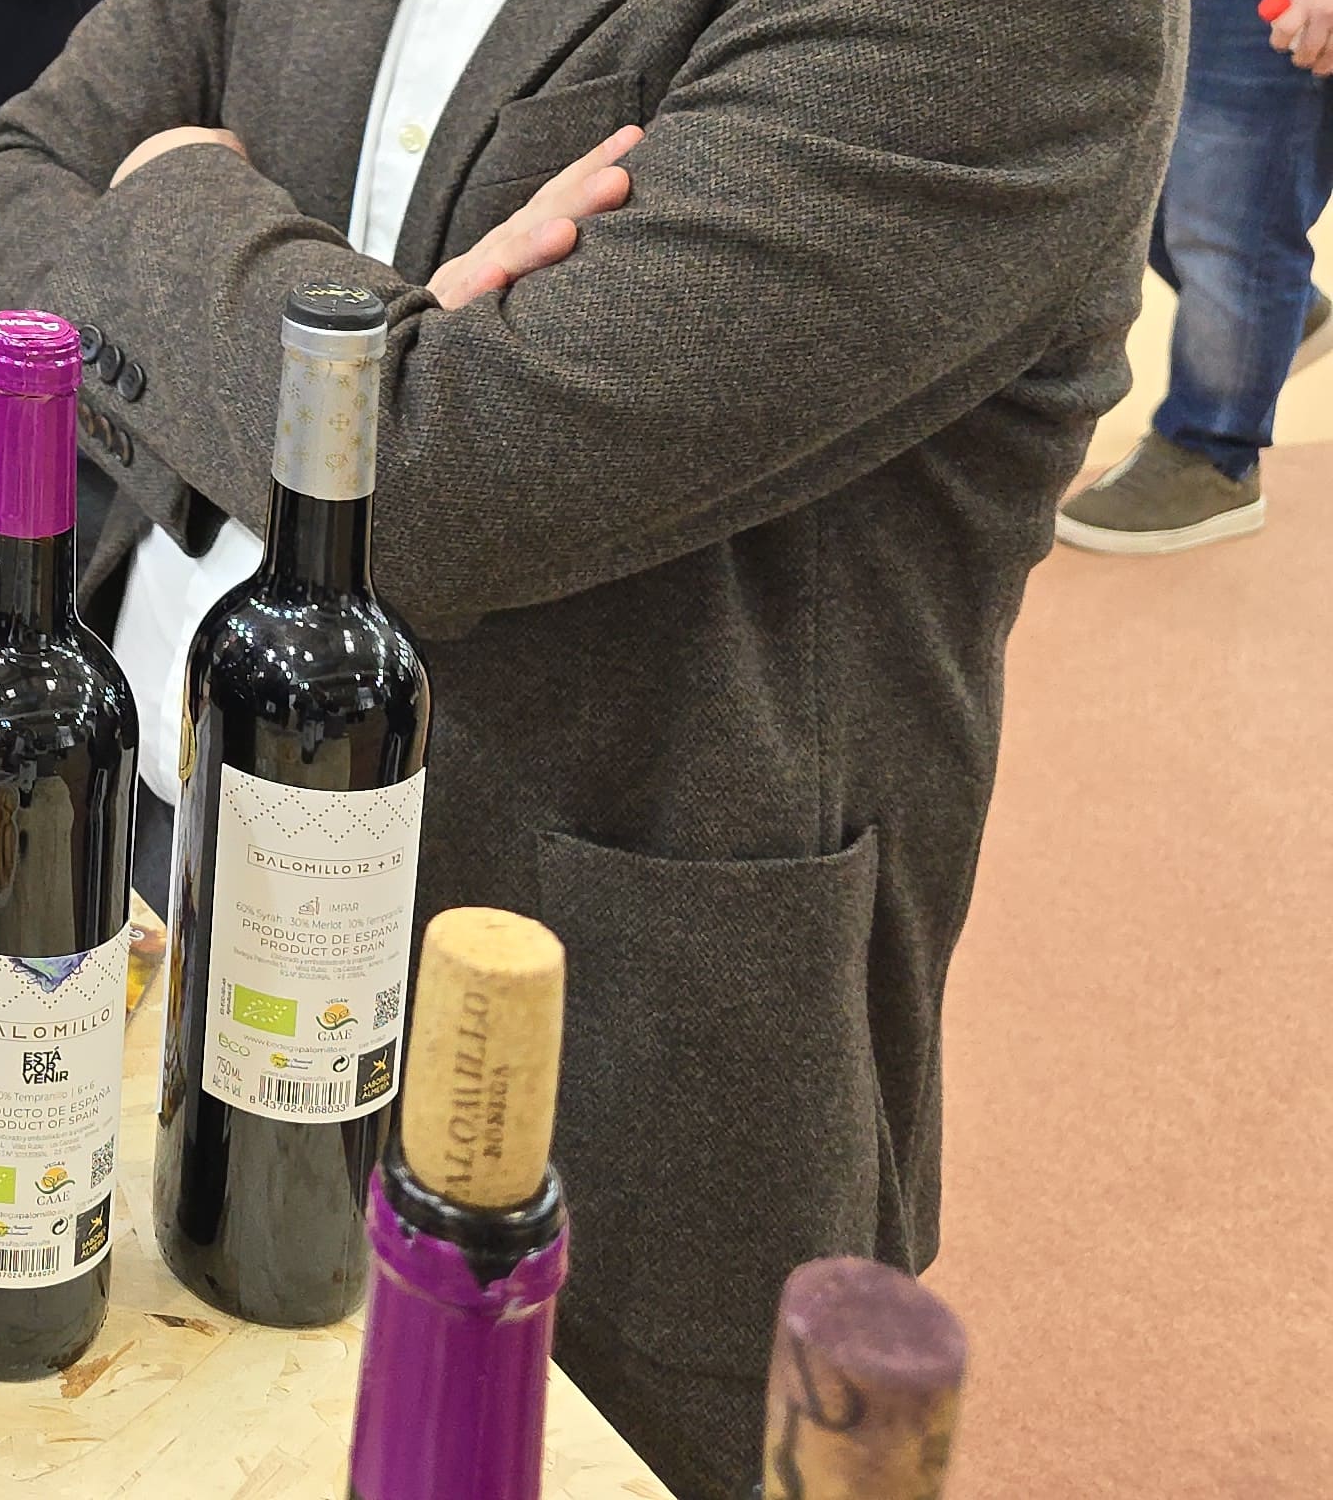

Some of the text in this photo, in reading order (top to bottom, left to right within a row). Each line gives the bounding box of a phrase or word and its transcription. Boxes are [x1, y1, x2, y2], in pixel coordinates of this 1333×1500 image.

[253, 851, 351, 875] PALOMILLO
[357, 863, 369, 874] 12
[392, 854, 401, 865] 12
[242, 918, 399, 945] PRODUCTO DE ESPAÑA
[312, 920, 342, 930] Merlot
[260, 937, 385, 957] PRODUCT OF SPAIN
[24, 1046, 62, 1062] ESTÁ
[23, 1061, 56, 1074] POR
[22, 1071, 69, 1085] VENIR
[48, 1105, 67, 1118] DE
[70, 1085, 112, 1113] ESPAÑA
[48, 1118, 67, 1129] OF
[68, 1106, 99, 1126] SPAIN
